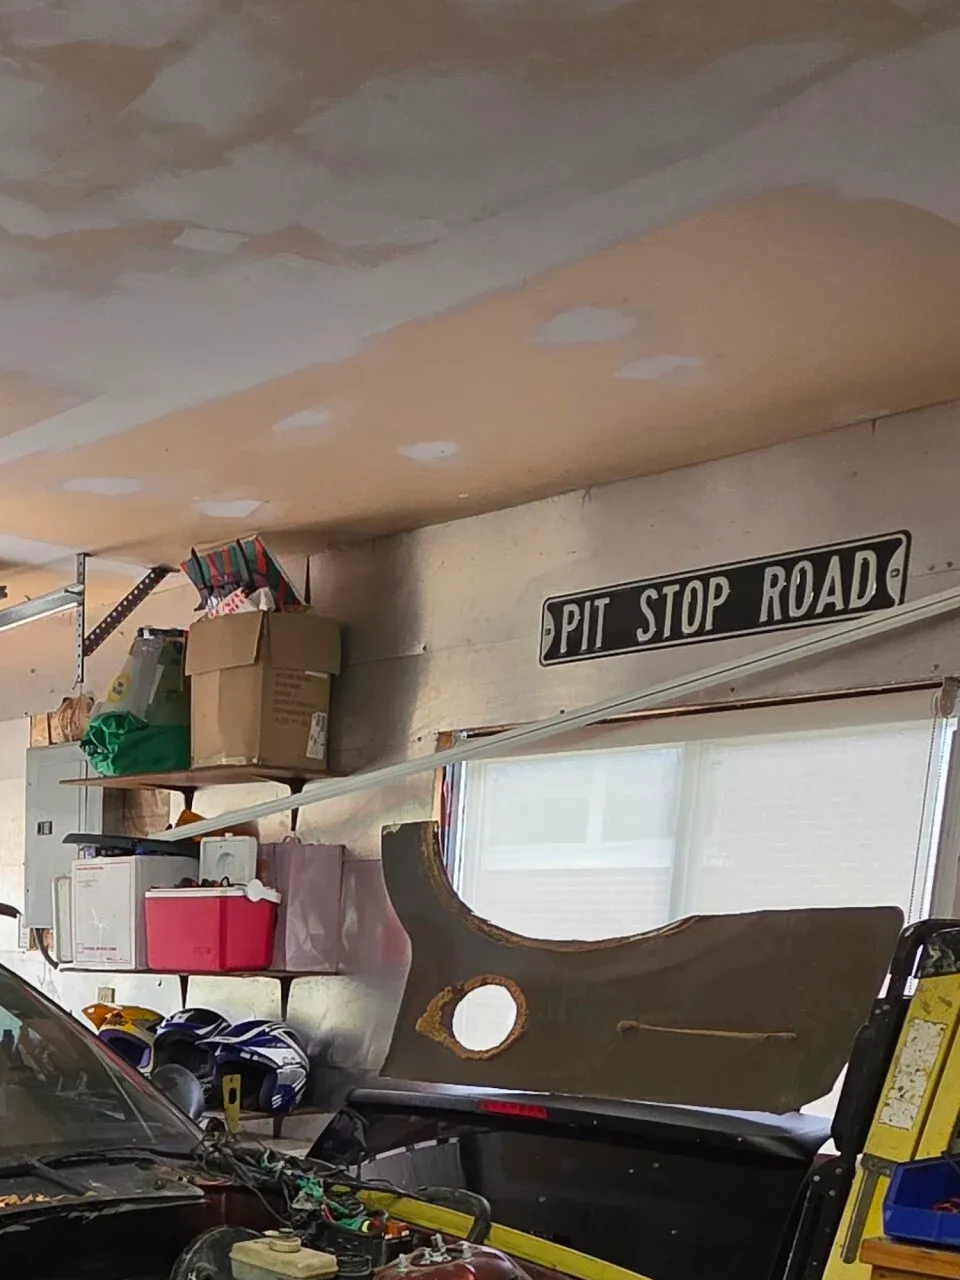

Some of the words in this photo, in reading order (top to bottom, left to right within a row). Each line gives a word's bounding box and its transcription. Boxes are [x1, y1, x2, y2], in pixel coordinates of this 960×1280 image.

[560, 597, 611, 654] PIT
[637, 576, 730, 643] STOP
[759, 550, 878, 624] ROAD
